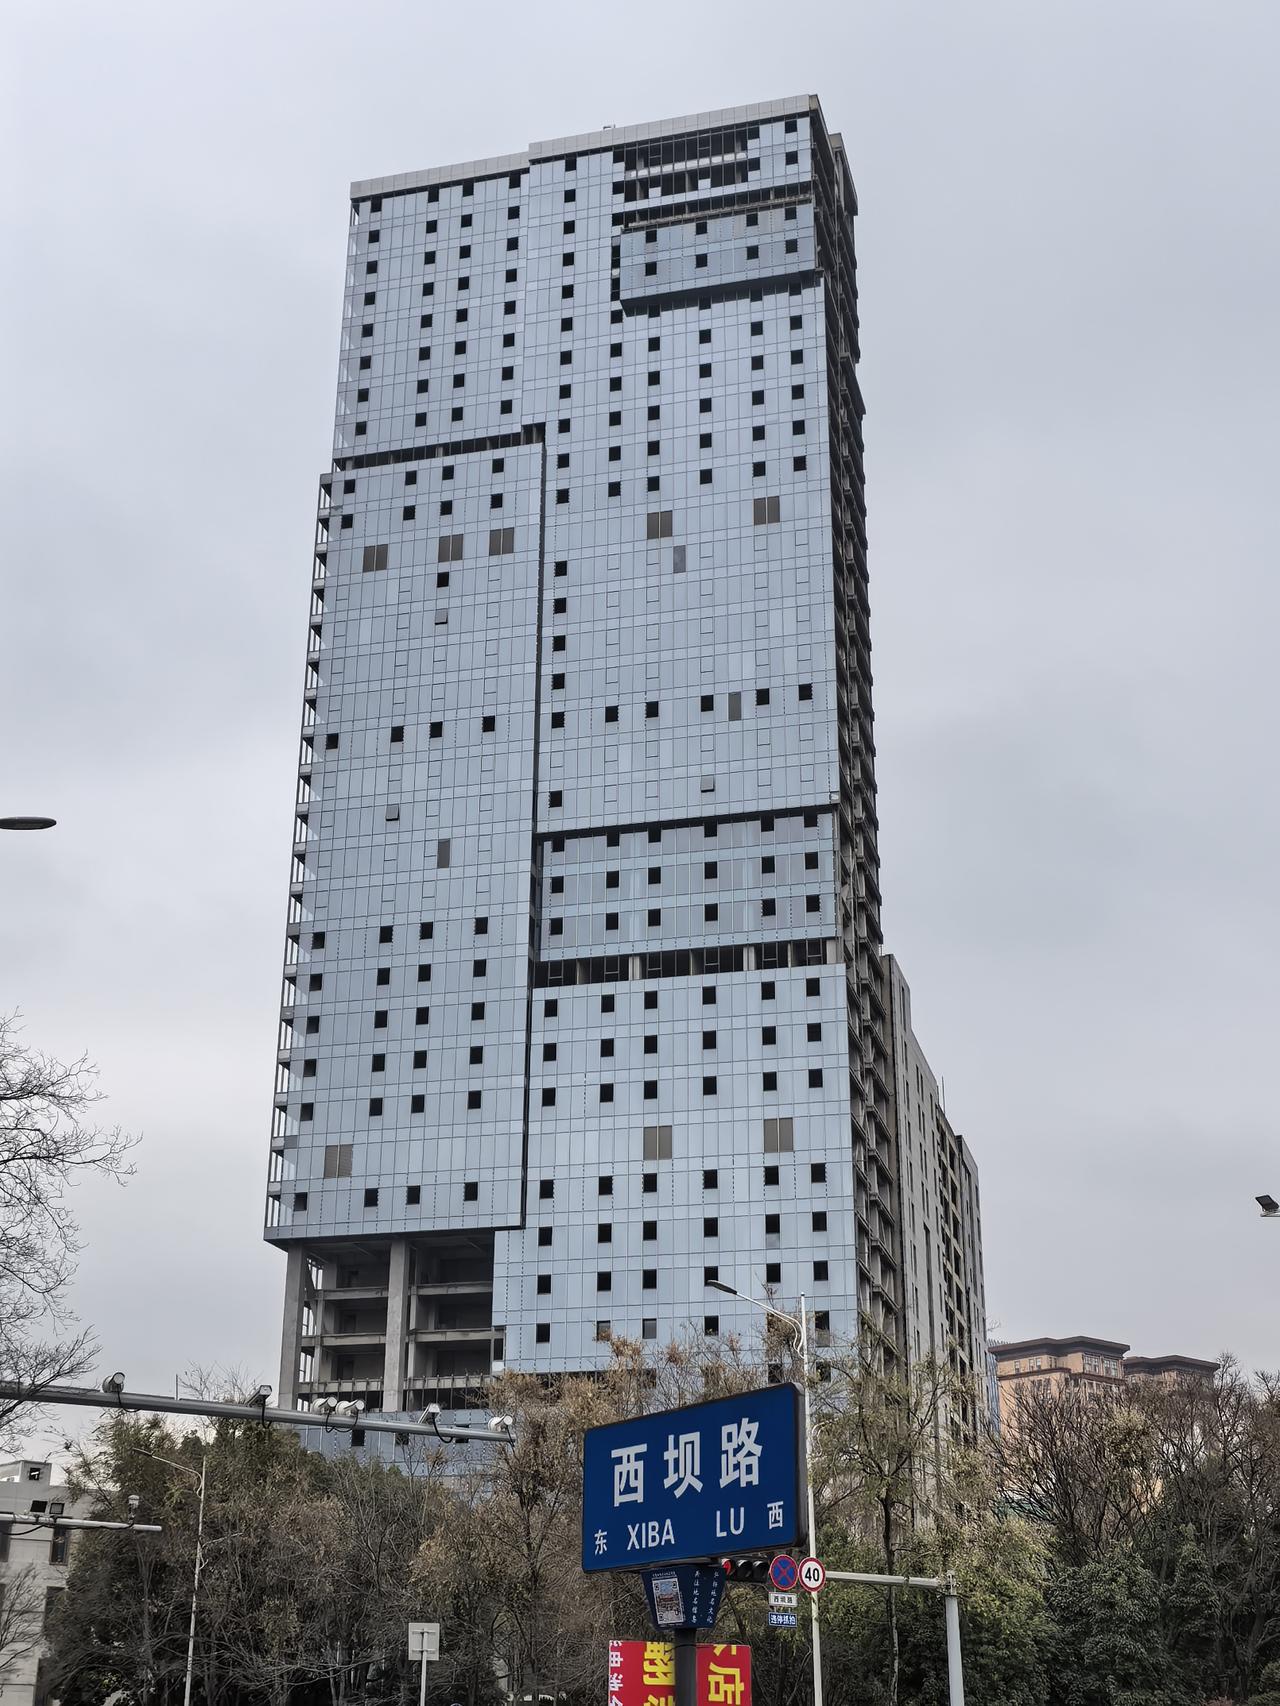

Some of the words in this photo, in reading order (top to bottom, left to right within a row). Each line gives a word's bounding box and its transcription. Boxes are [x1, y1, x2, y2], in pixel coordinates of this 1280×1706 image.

[611, 1417, 763, 1507] 西坝路
[627, 1518, 675, 1550] XIBA
[716, 1507, 745, 1538] LU
[767, 1501, 784, 1530] 西
[594, 1529, 608, 1555] 东
[804, 1567, 820, 1582] 40
